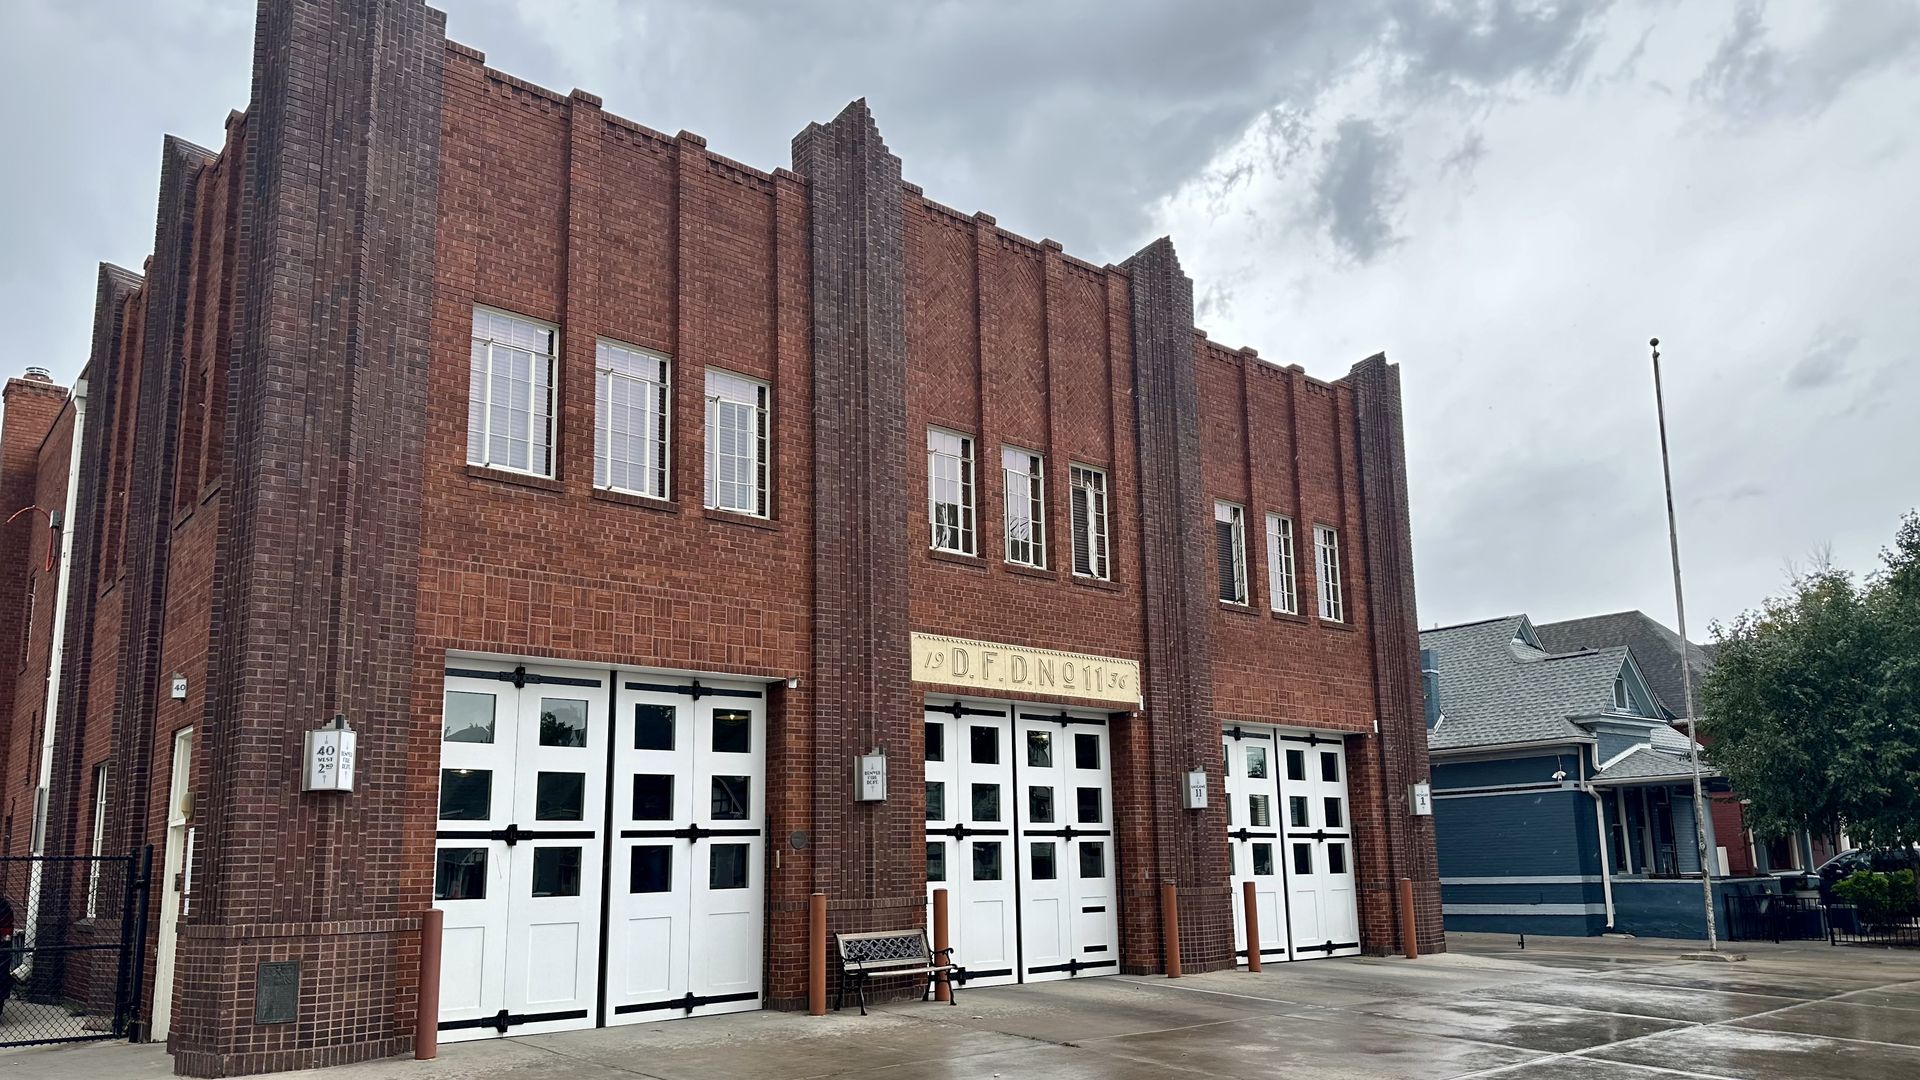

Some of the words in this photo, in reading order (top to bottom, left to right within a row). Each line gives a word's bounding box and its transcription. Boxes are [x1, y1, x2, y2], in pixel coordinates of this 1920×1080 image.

[924, 650, 945, 669] 19
[1083, 665, 1103, 692] 11
[1108, 671, 1128, 690] 36
[317, 745, 335, 756] 40
[1196, 789, 1202, 797] 11
[1420, 797, 1426, 805] 1
